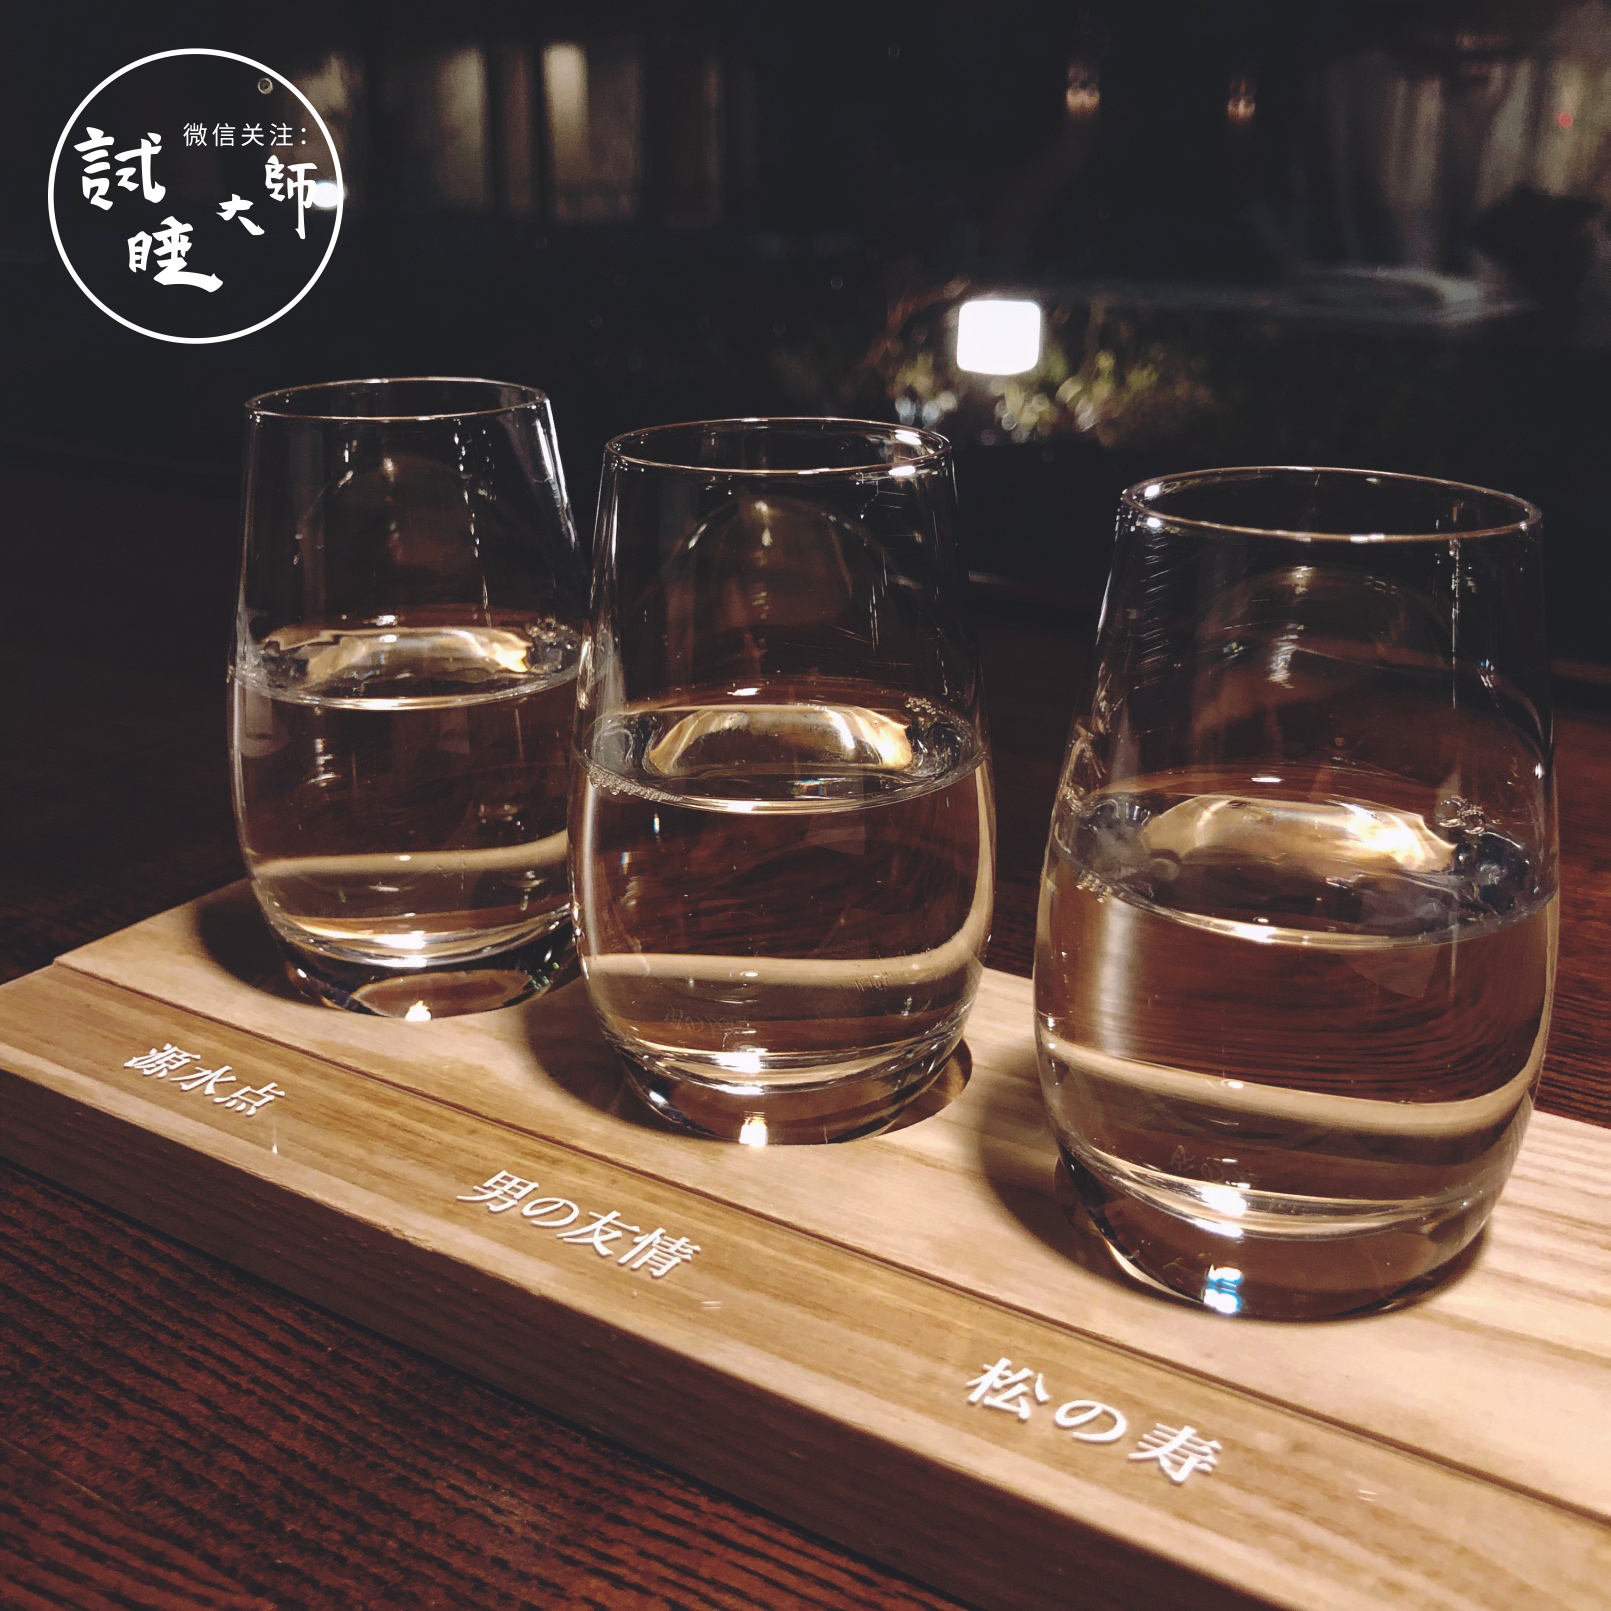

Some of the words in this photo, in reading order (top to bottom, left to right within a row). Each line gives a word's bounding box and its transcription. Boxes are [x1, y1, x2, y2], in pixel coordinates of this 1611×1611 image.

[123, 1043, 286, 1116] 源水点
[458, 1171, 700, 1276] 男の友情
[967, 1358, 1221, 1481] 松の寿
